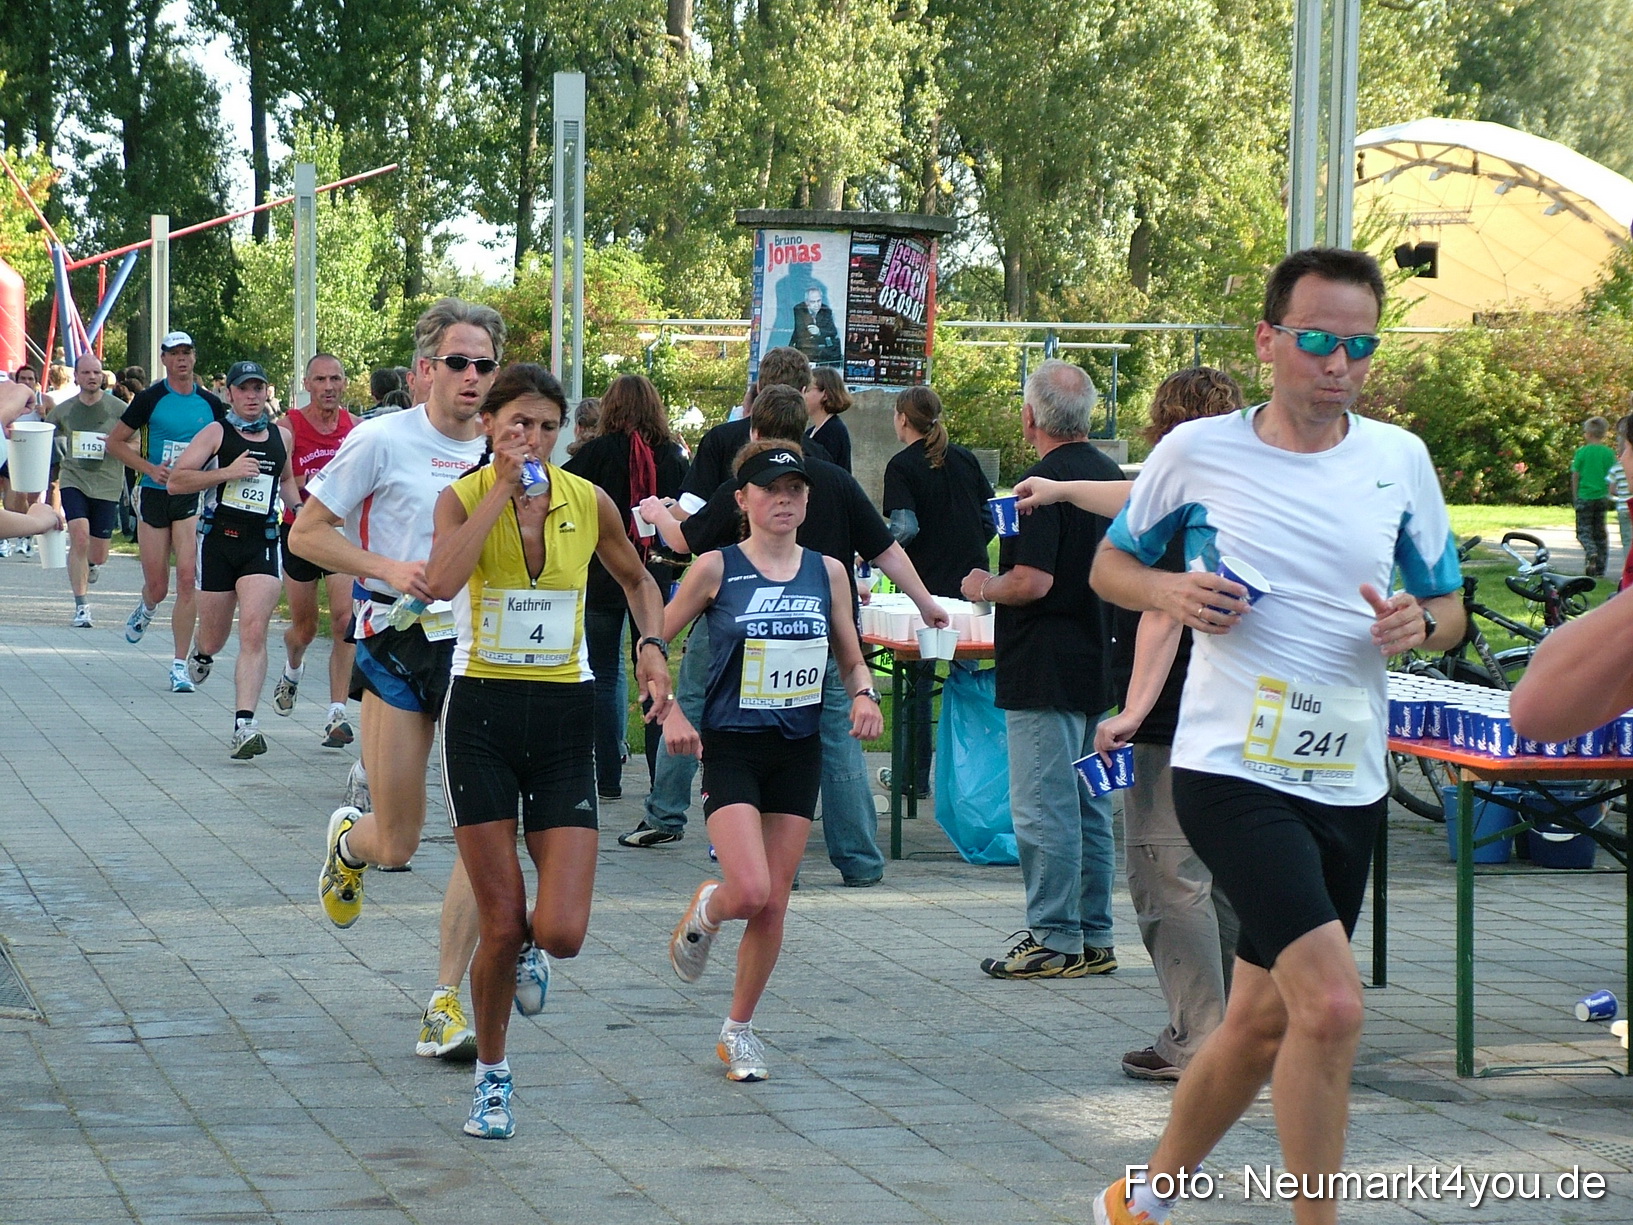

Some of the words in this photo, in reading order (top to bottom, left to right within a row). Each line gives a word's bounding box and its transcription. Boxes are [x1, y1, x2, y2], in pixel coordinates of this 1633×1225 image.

[774, 235, 803, 246] Bruno
[768, 242, 822, 273] Jonas
[879, 285, 924, 324] 08.09.07
[82, 443, 102, 451] 1153
[300, 448, 336, 466] Ausdaue
[431, 458, 475, 469] SportSc
[242, 488, 264, 502] 623
[507, 597, 552, 611] Kathrin
[760, 599, 820, 613] NAGEL
[483, 617, 489, 628] A
[746, 621, 768, 637] SC
[772, 620, 809, 635] Roth
[812, 621, 827, 635] 52
[529, 624, 545, 644] 4
[769, 667, 819, 689] 1160
[1291, 691, 1321, 714] Udo
[1255, 714, 1264, 728] A
[1293, 730, 1348, 757] 241
